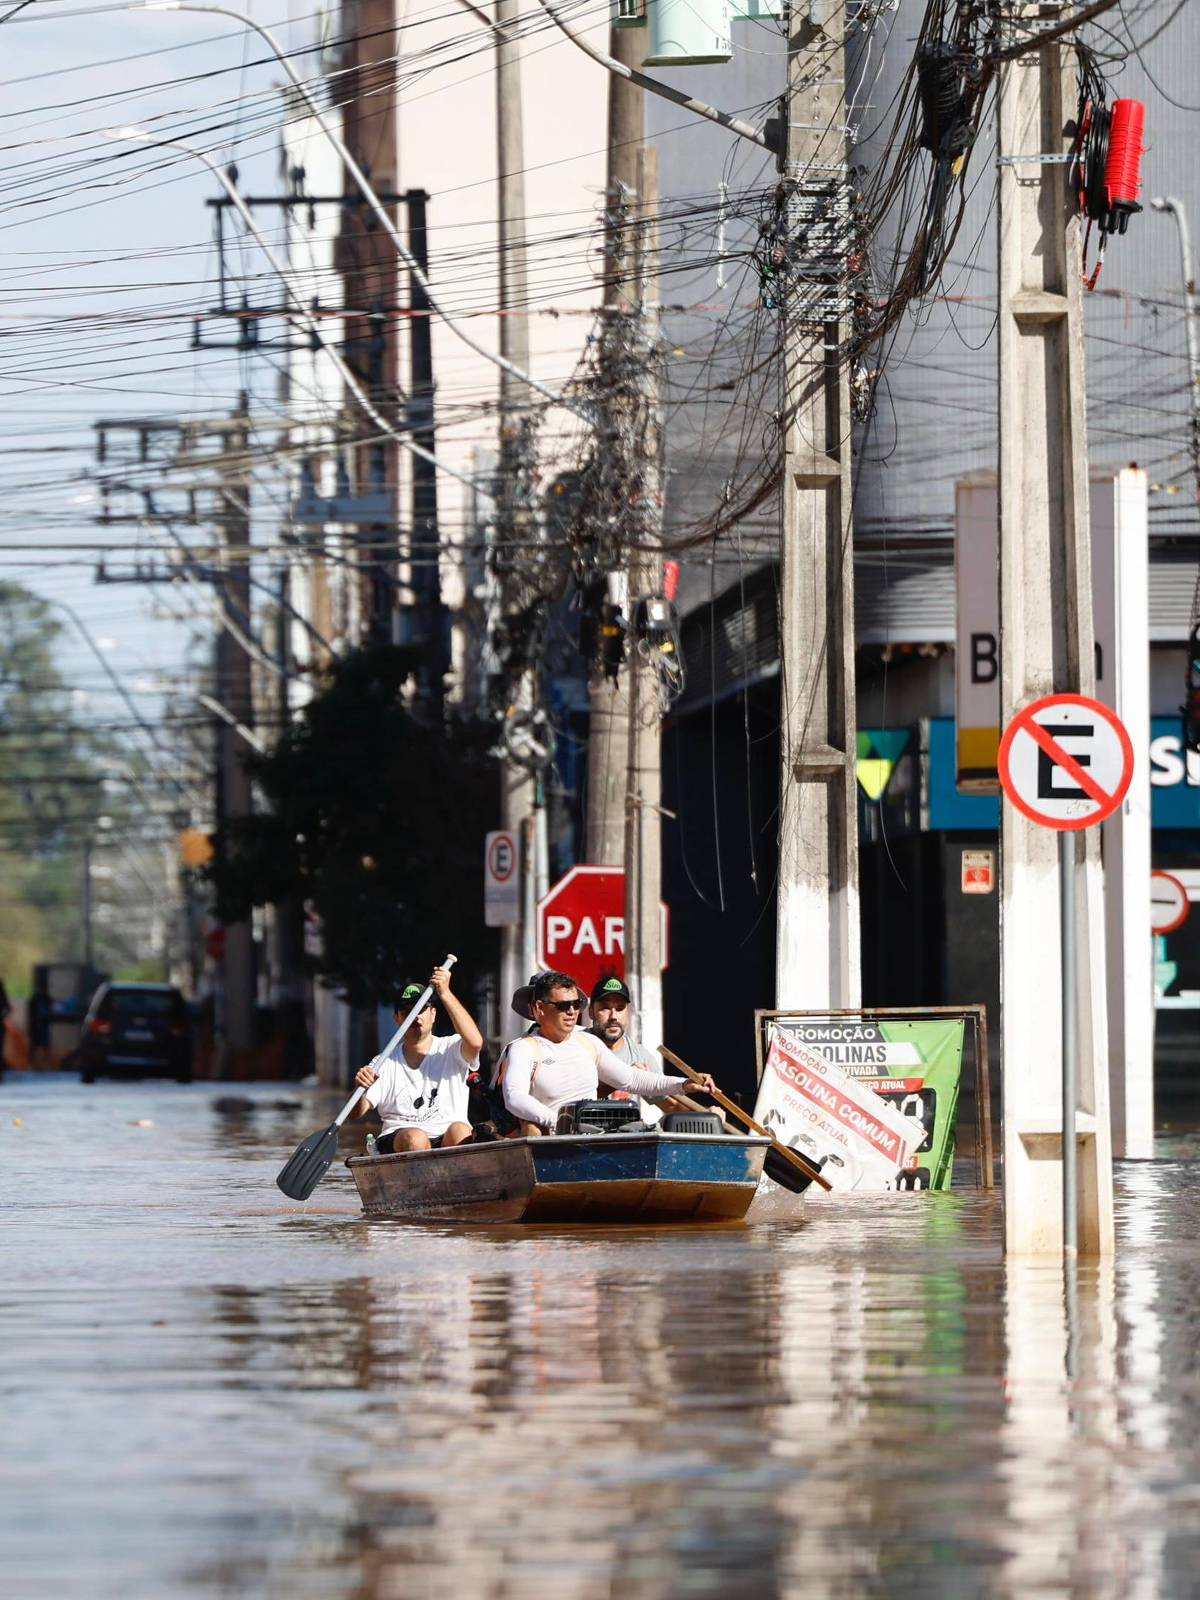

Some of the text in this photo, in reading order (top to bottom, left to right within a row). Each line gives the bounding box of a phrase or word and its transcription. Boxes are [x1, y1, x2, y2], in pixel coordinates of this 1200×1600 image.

[1038, 725, 1094, 799] E
[496, 844, 508, 872] E
[547, 916, 625, 955] PAR
[812, 1045, 887, 1063] OLINAS
[881, 1080, 906, 1089] ATUAL
[783, 1094, 818, 1122] PREÇO
[817, 1120, 849, 1147] ATUAL
[838, 1103, 897, 1151] COMUM
